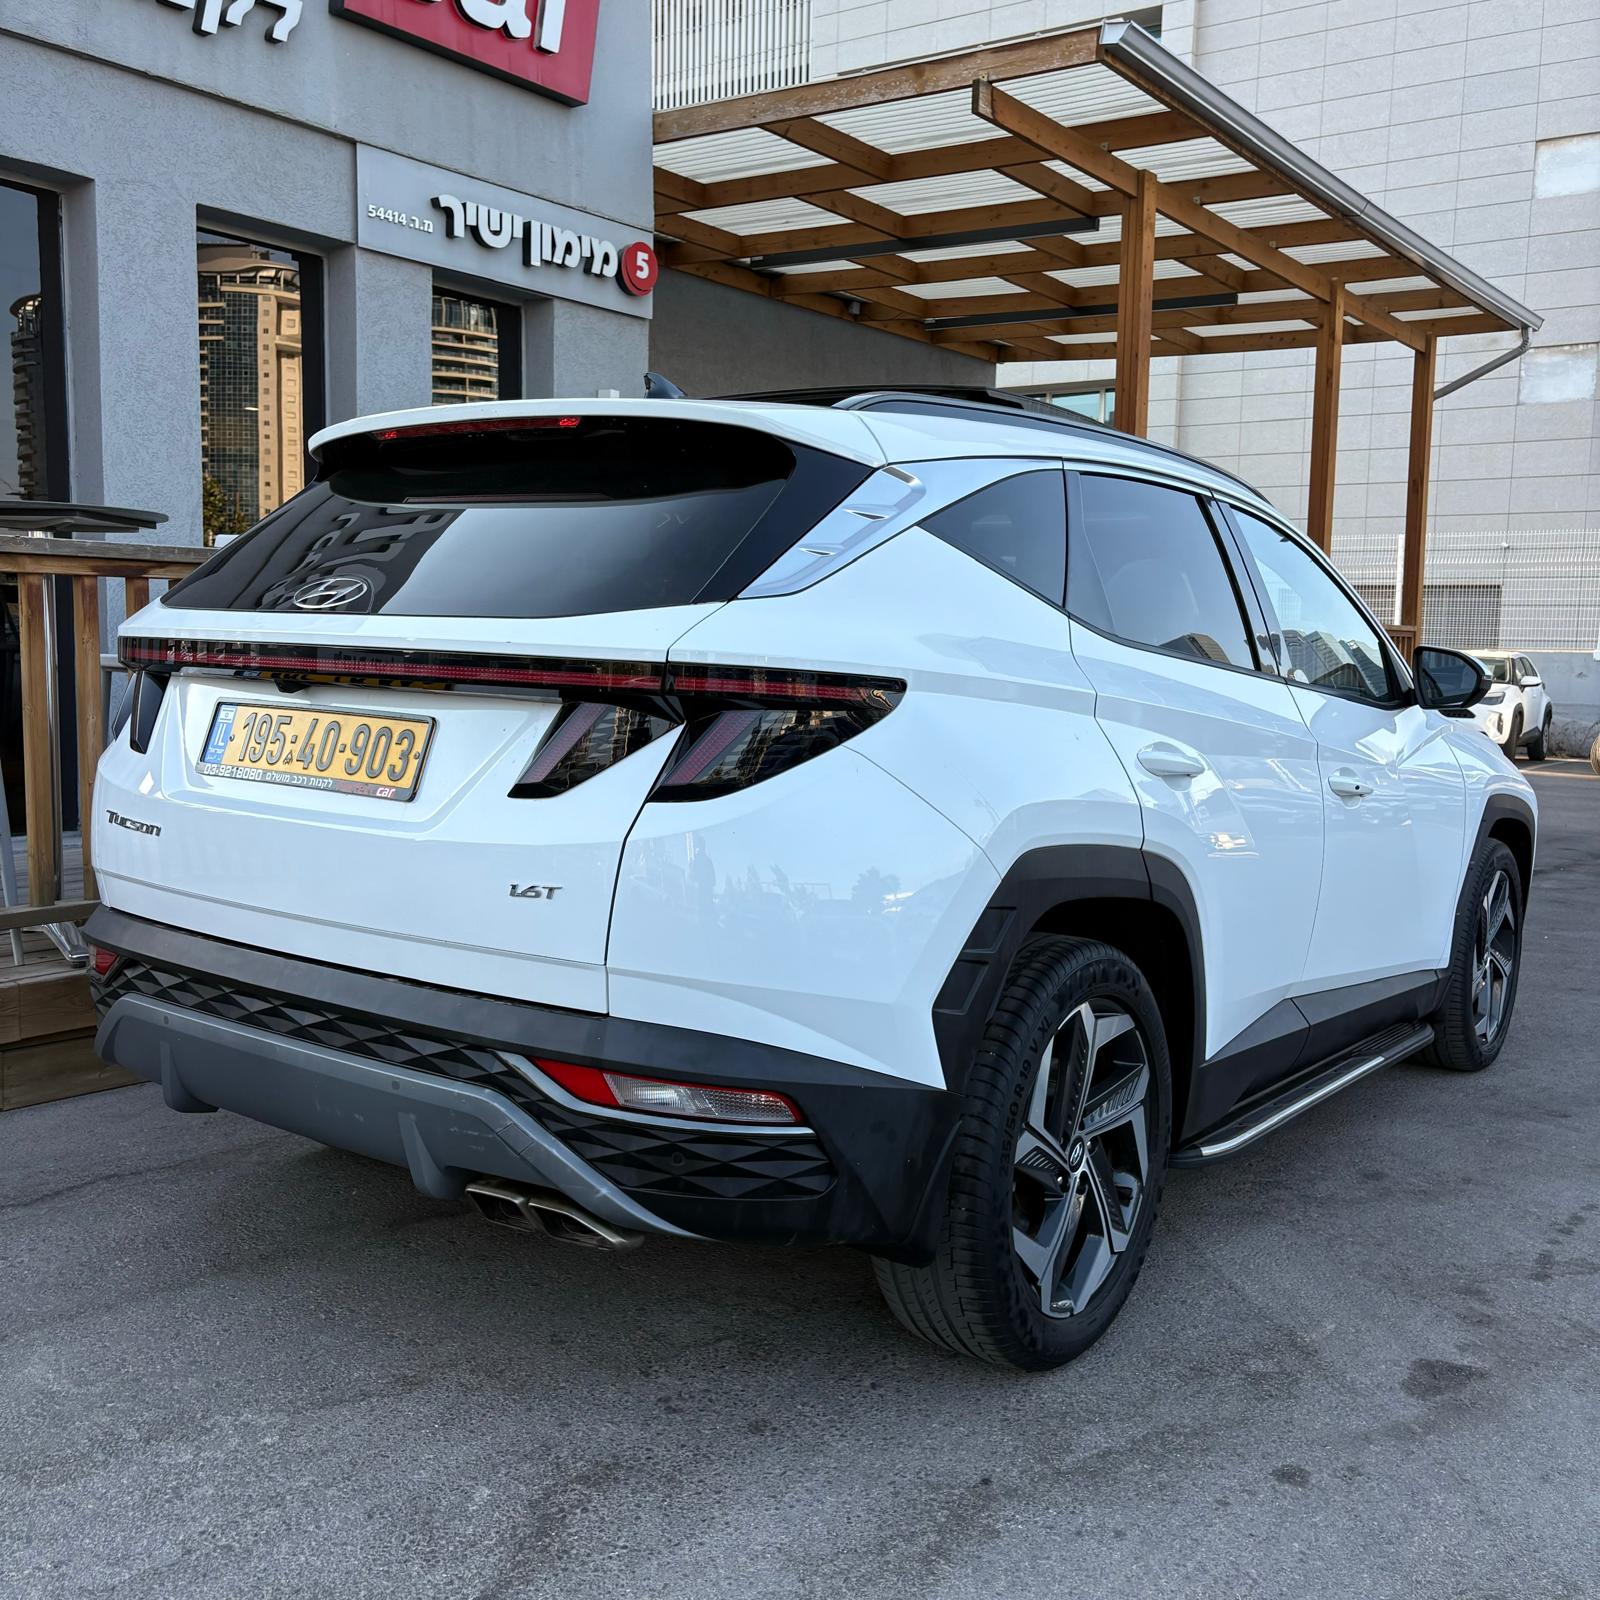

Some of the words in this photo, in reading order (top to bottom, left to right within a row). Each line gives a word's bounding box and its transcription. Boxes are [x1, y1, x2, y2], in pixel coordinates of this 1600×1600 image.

[367, 204, 407, 226] 54414
[433, 194, 524, 250] ישיר
[527, 219, 619, 279] מימון
[213, 723, 227, 746] IL
[265, 770, 290, 783] מושלם
[291, 775, 308, 785] רכב
[309, 776, 333, 789] לקנות
[376, 786, 396, 798] car
[1019, 1059, 1033, 1081] 19
